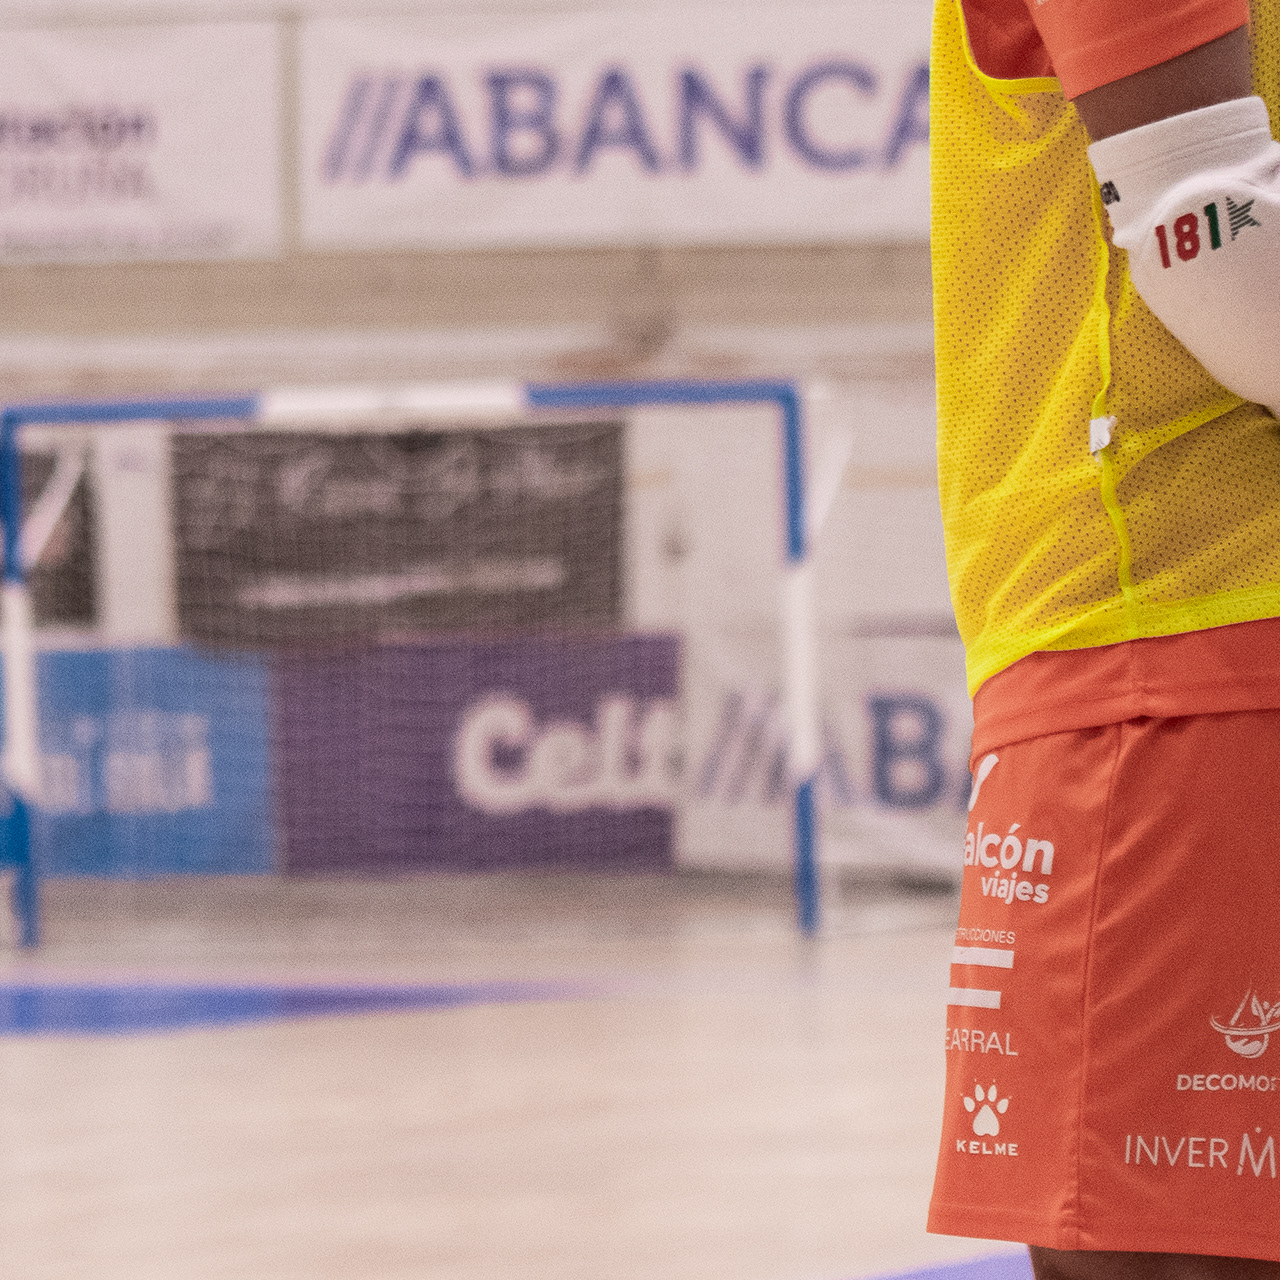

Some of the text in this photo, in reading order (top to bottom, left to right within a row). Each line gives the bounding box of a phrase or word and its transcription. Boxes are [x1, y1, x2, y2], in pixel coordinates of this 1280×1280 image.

[1155, 202, 1222, 269] 181
[980, 870, 1051, 905] viajes
[955, 1138, 1019, 1157] KELME
[1124, 1134, 1228, 1169] INVER
